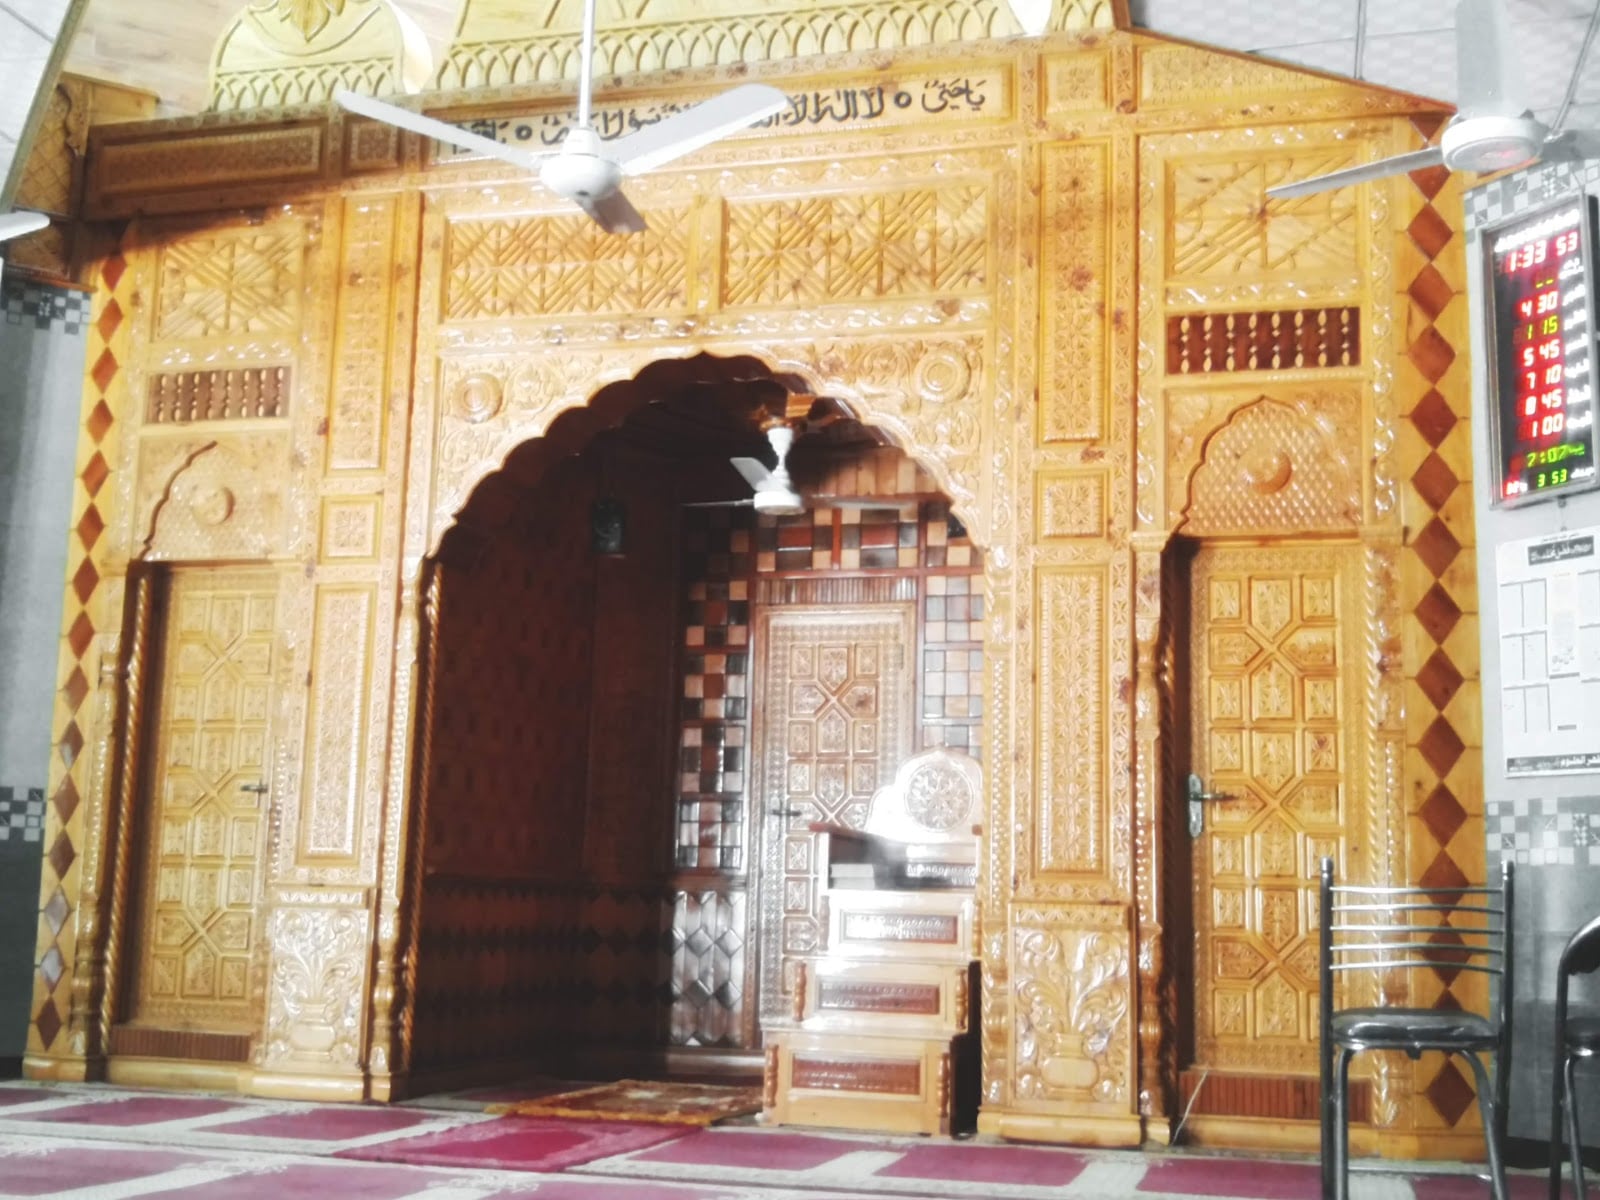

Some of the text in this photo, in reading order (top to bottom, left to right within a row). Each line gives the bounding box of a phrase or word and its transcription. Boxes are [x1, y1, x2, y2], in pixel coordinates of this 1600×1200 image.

[1556, 232, 1578, 256] 53
[1521, 300, 1532, 317] 4
[1537, 291, 1558, 314] 30
[1527, 324, 1533, 340] 1
[1543, 315, 1558, 335] 15
[1523, 347, 1534, 366] 5
[1539, 339, 1560, 359] 45
[1545, 364, 1562, 384] 10
[1541, 389, 1562, 409] 45
[1532, 421, 1538, 438] 1
[1542, 412, 1564, 435] 00
[1538, 474, 1546, 488] 3
[1551, 469, 1568, 485] 53
